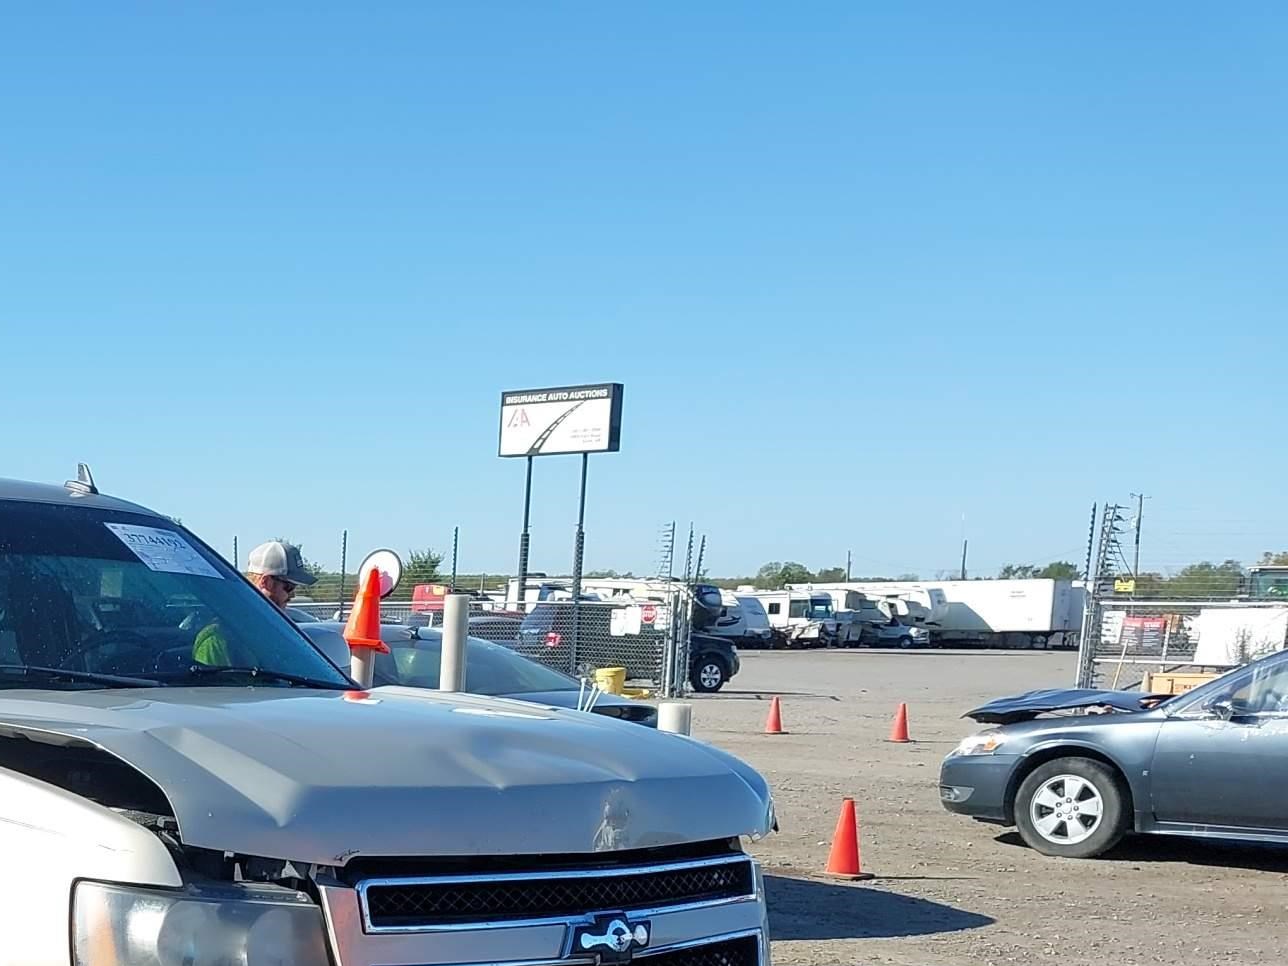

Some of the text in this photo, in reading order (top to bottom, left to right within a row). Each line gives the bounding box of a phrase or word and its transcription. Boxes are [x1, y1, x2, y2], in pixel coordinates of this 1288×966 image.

[505, 389, 608, 404] INSURANCE AUTO AUCTIONS
